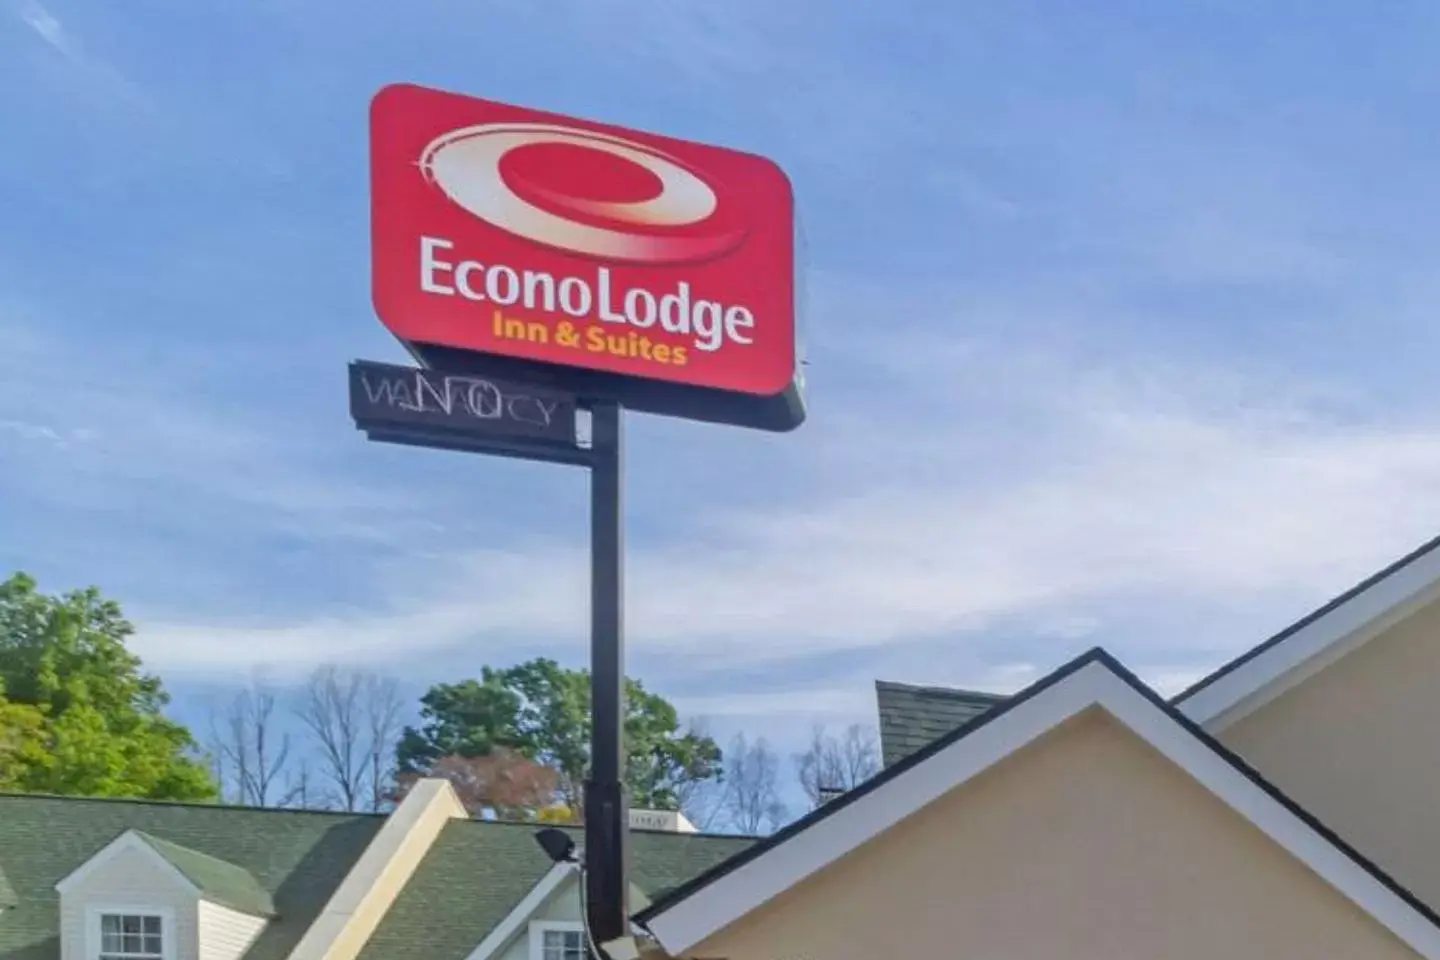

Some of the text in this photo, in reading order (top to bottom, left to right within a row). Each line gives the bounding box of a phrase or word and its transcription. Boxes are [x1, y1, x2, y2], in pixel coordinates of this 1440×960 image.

[420, 235, 755, 351] EconoLodge
[493, 311, 688, 366] Inn & Suites
